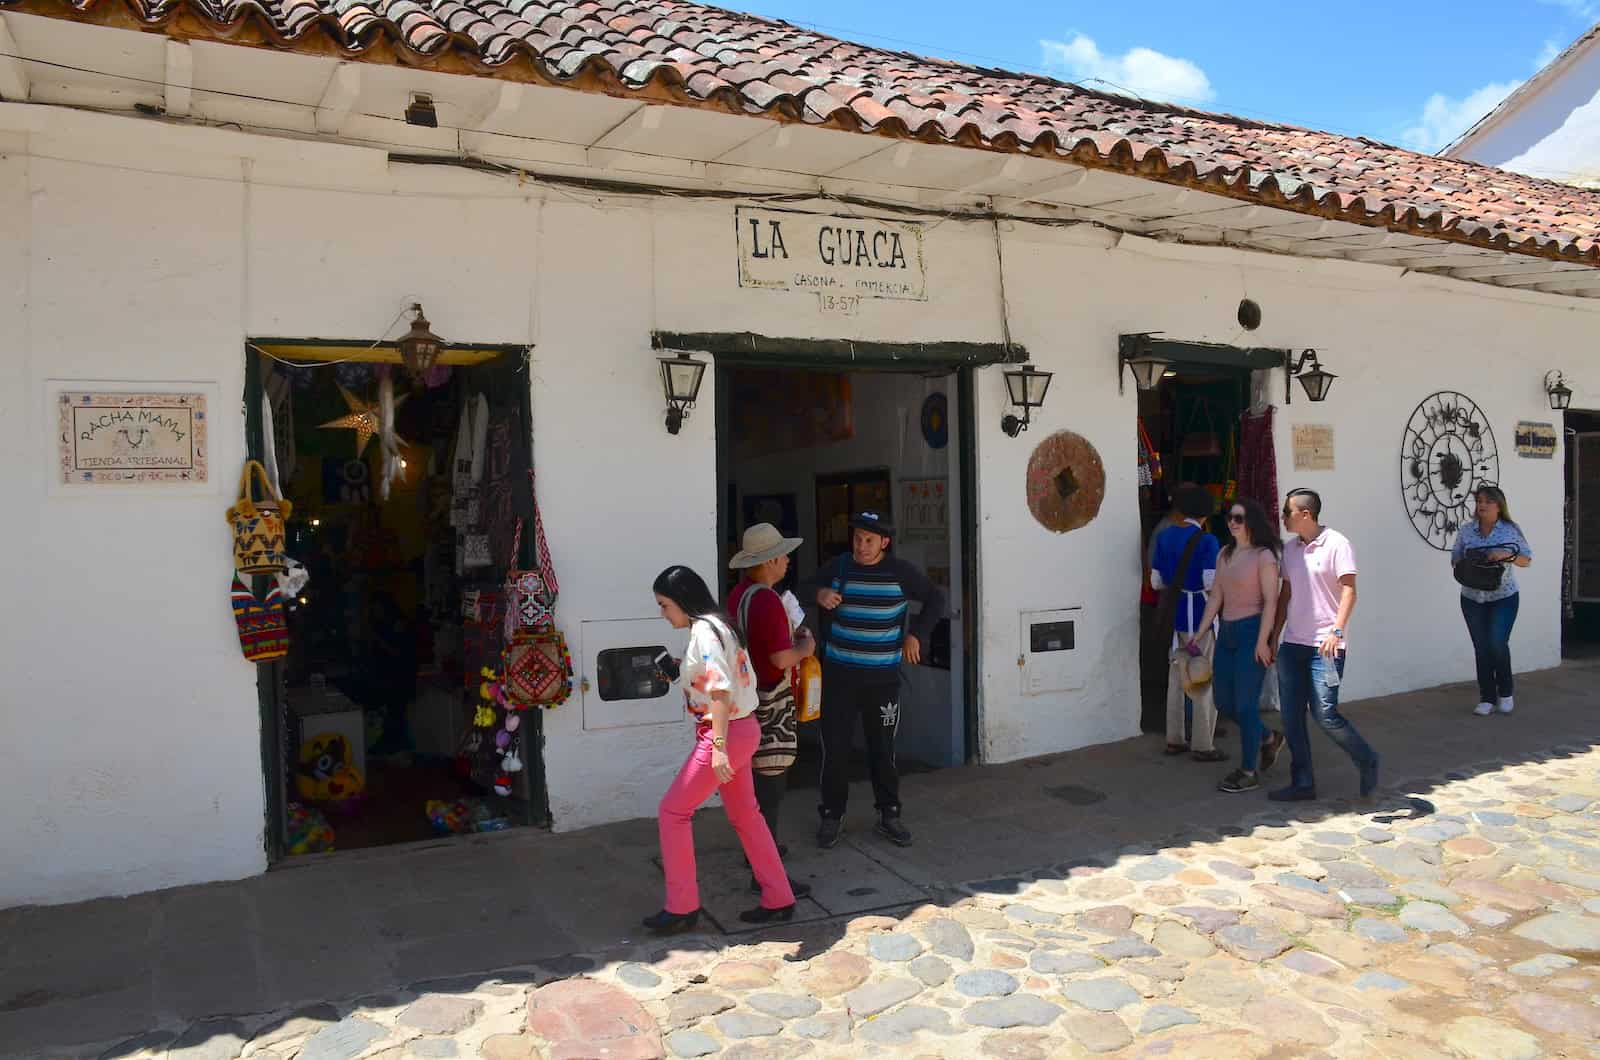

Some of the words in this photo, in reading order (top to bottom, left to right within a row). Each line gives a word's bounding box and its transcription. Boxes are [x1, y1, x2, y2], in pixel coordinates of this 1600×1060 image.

[749, 218, 789, 259] LA
[818, 225, 907, 269] GUACA
[81, 410, 134, 441] PACHA
[138, 410, 186, 442] MAMA
